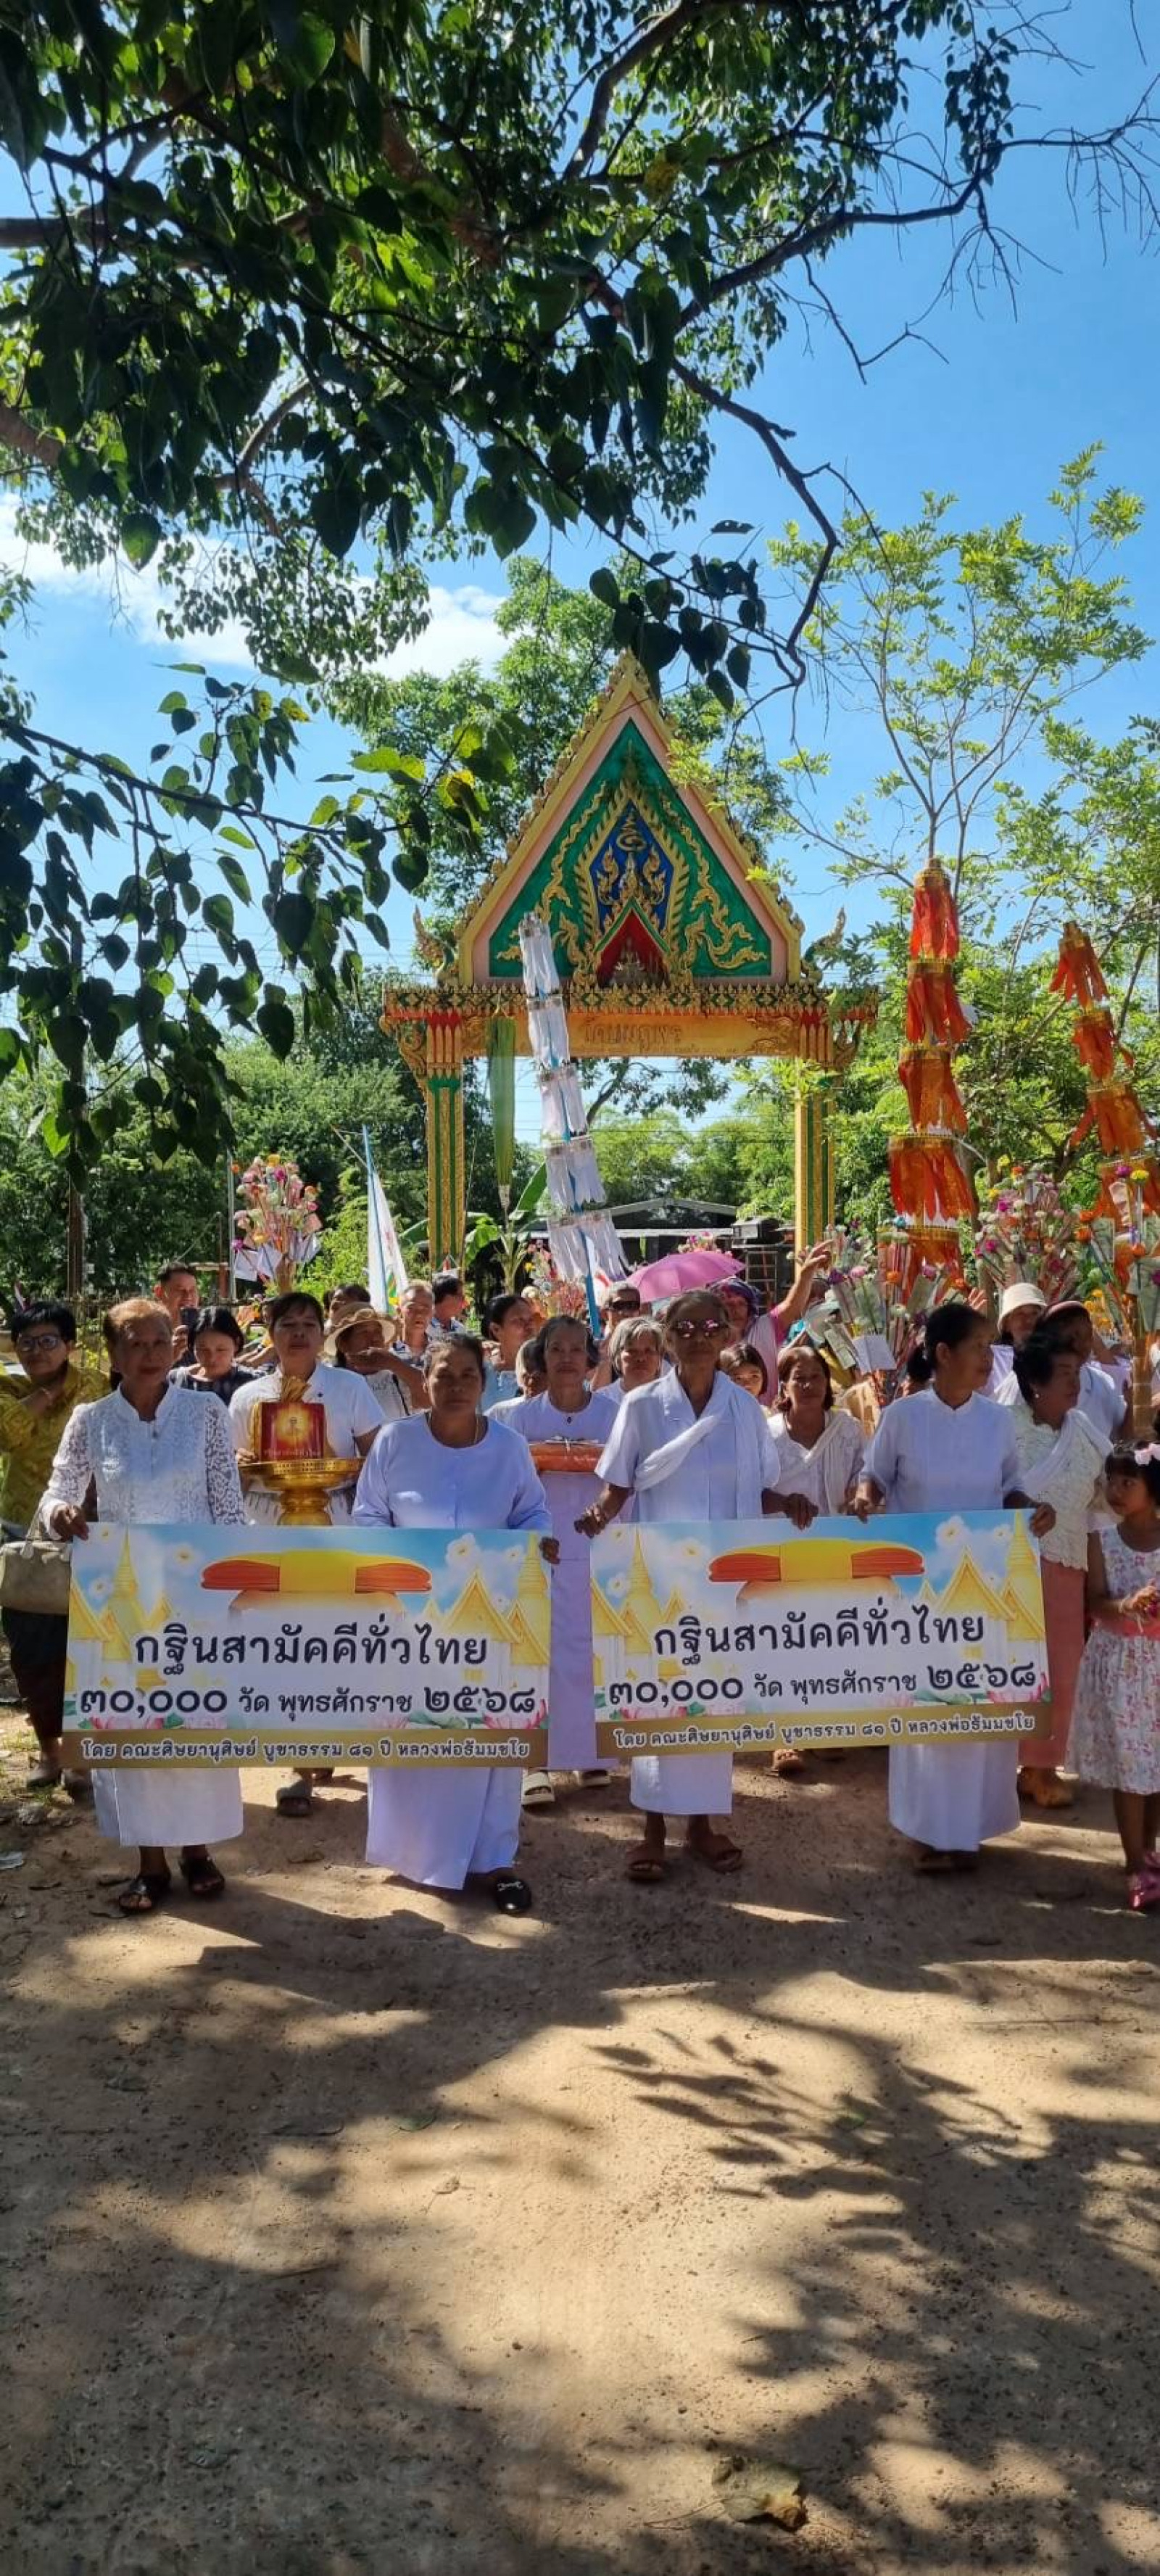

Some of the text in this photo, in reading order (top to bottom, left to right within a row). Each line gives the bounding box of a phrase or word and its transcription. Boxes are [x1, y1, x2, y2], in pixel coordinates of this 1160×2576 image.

[136, 1613, 487, 1676] กฐินสามัคคีทั่วไทย
[654, 1595, 985, 1665] กฐินสามัคคีทั่วไทย
[80, 1685, 535, 1721] ๓๐,๐๐๐ วัด พุทธศักราช ๒๕๖๘
[609, 1661, 1037, 1709] ๓๐,๐๐๐ วัด พุทธศักราช ๒๕๖๘
[82, 1737, 530, 1764] โดย คณะศิษยานุศิษย์ บูชาธรรม ๘๑ ปี หลวงพ่อธัมมชโย
[613, 1711, 1035, 1749] โดย คณะศิษยานุศิษย์ บูชาธรรม ๘๑ ปี หลวงพ่อธัมมชโย
